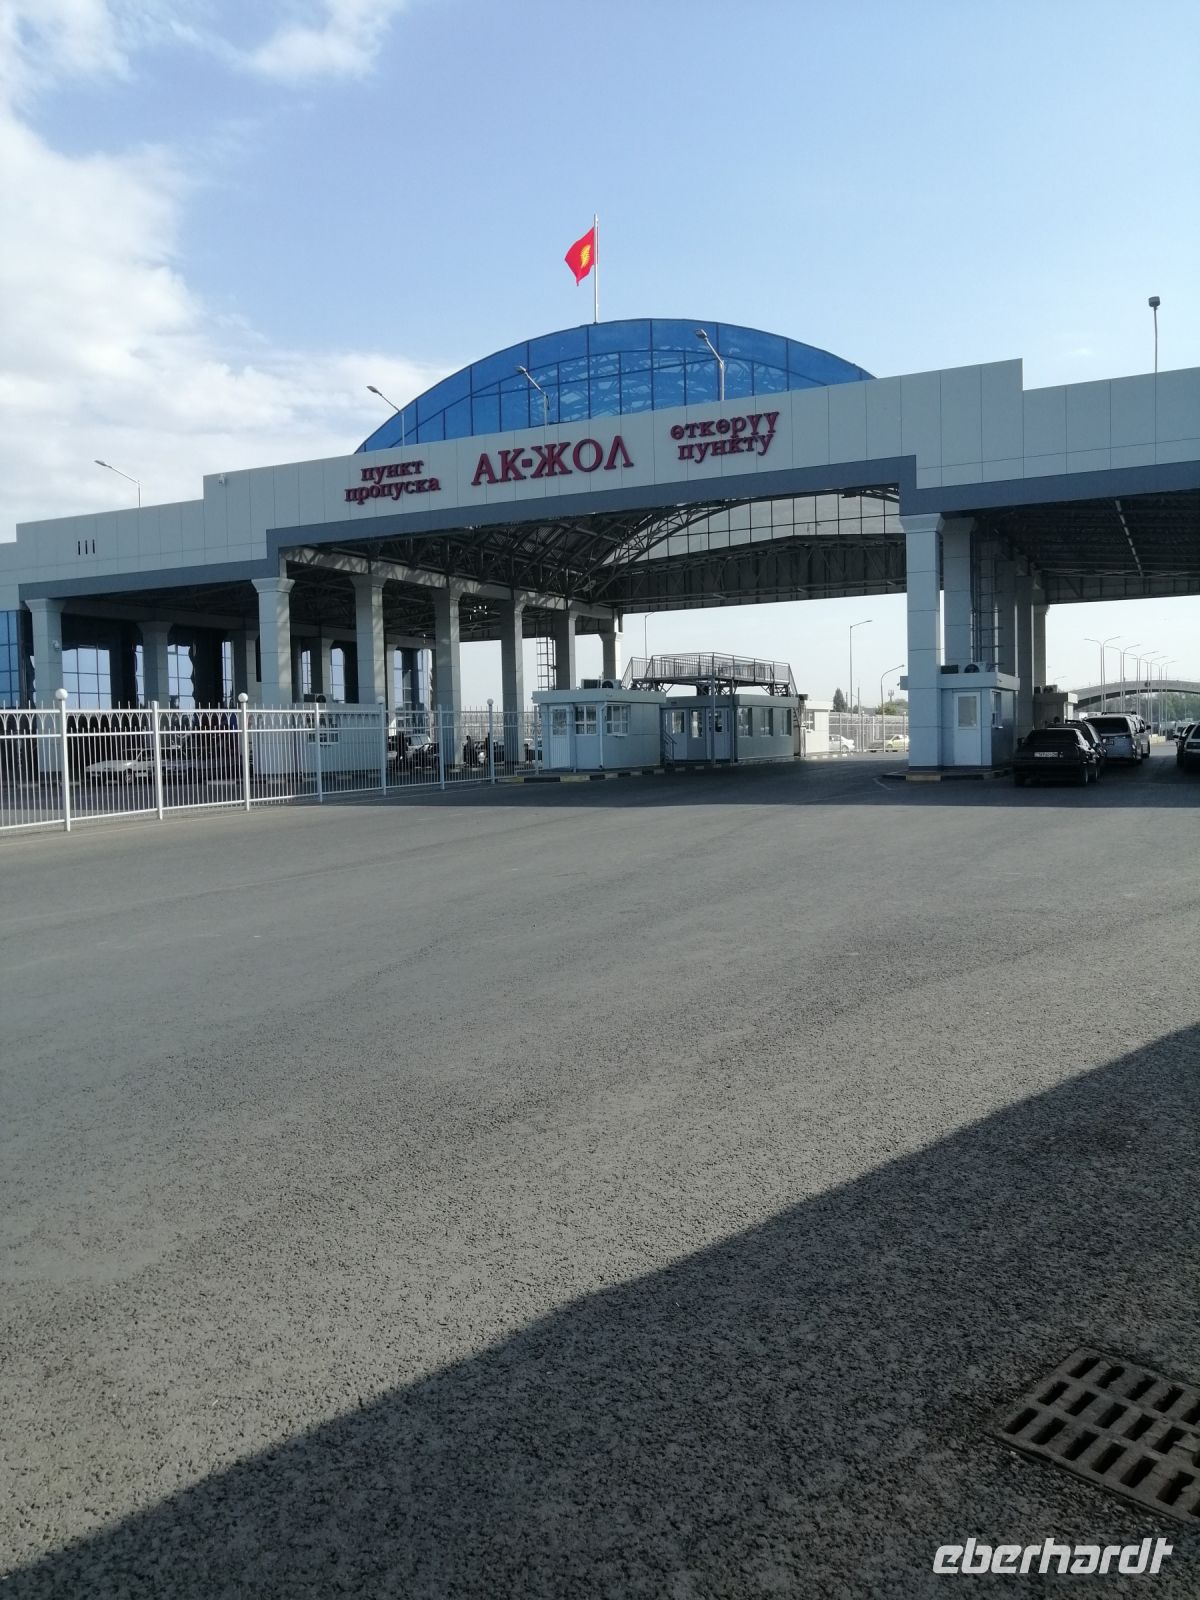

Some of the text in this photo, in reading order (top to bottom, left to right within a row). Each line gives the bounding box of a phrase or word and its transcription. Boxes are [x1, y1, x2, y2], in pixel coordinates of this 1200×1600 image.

[670, 411, 780, 440] өткөрүү
[471, 435, 634, 485] АК-ЖОЛ
[677, 433, 774, 464] пункту
[360, 459, 424, 484] пункт
[344, 477, 442, 505] пропуска
